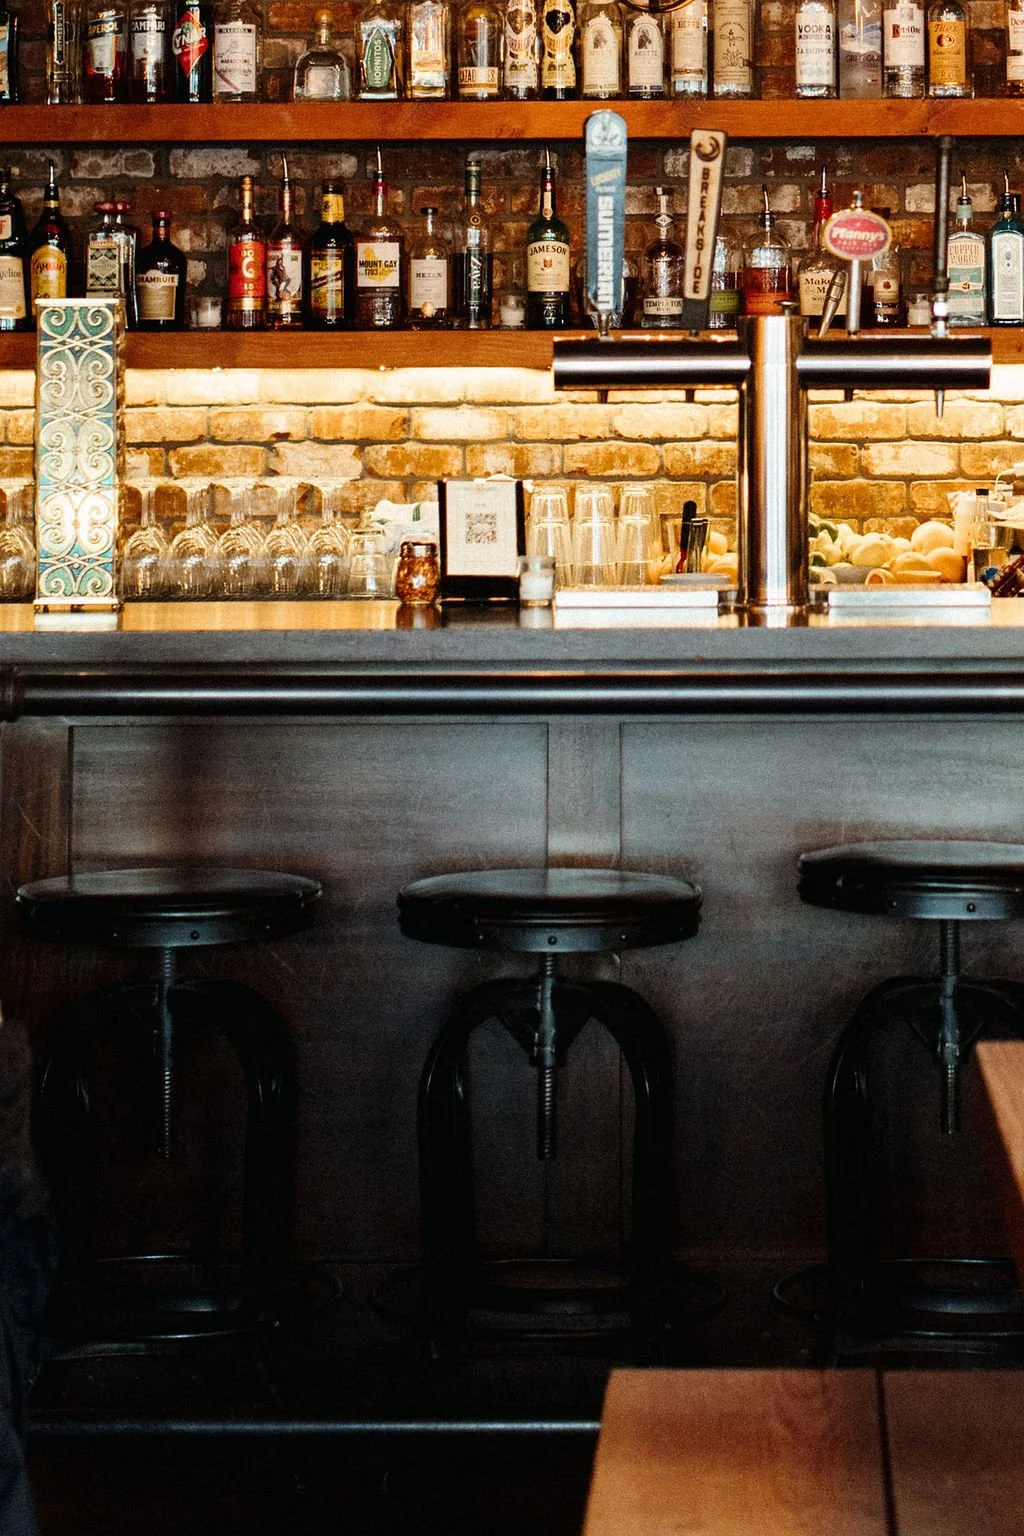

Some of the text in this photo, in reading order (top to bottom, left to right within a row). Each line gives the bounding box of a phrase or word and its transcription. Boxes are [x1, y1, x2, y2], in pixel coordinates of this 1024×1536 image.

[88, 21, 119, 36] APEROL
[798, 24, 831, 34] VODKA
[374, 38, 382, 84] HORNITOS
[692, 167, 711, 294] BREAKSIDE
[529, 244, 568, 256] JAMESON
[597, 195, 615, 310] SUMERIAN
[359, 260, 397, 268] MOUNT GAY
[365, 268, 378, 276] 1703
